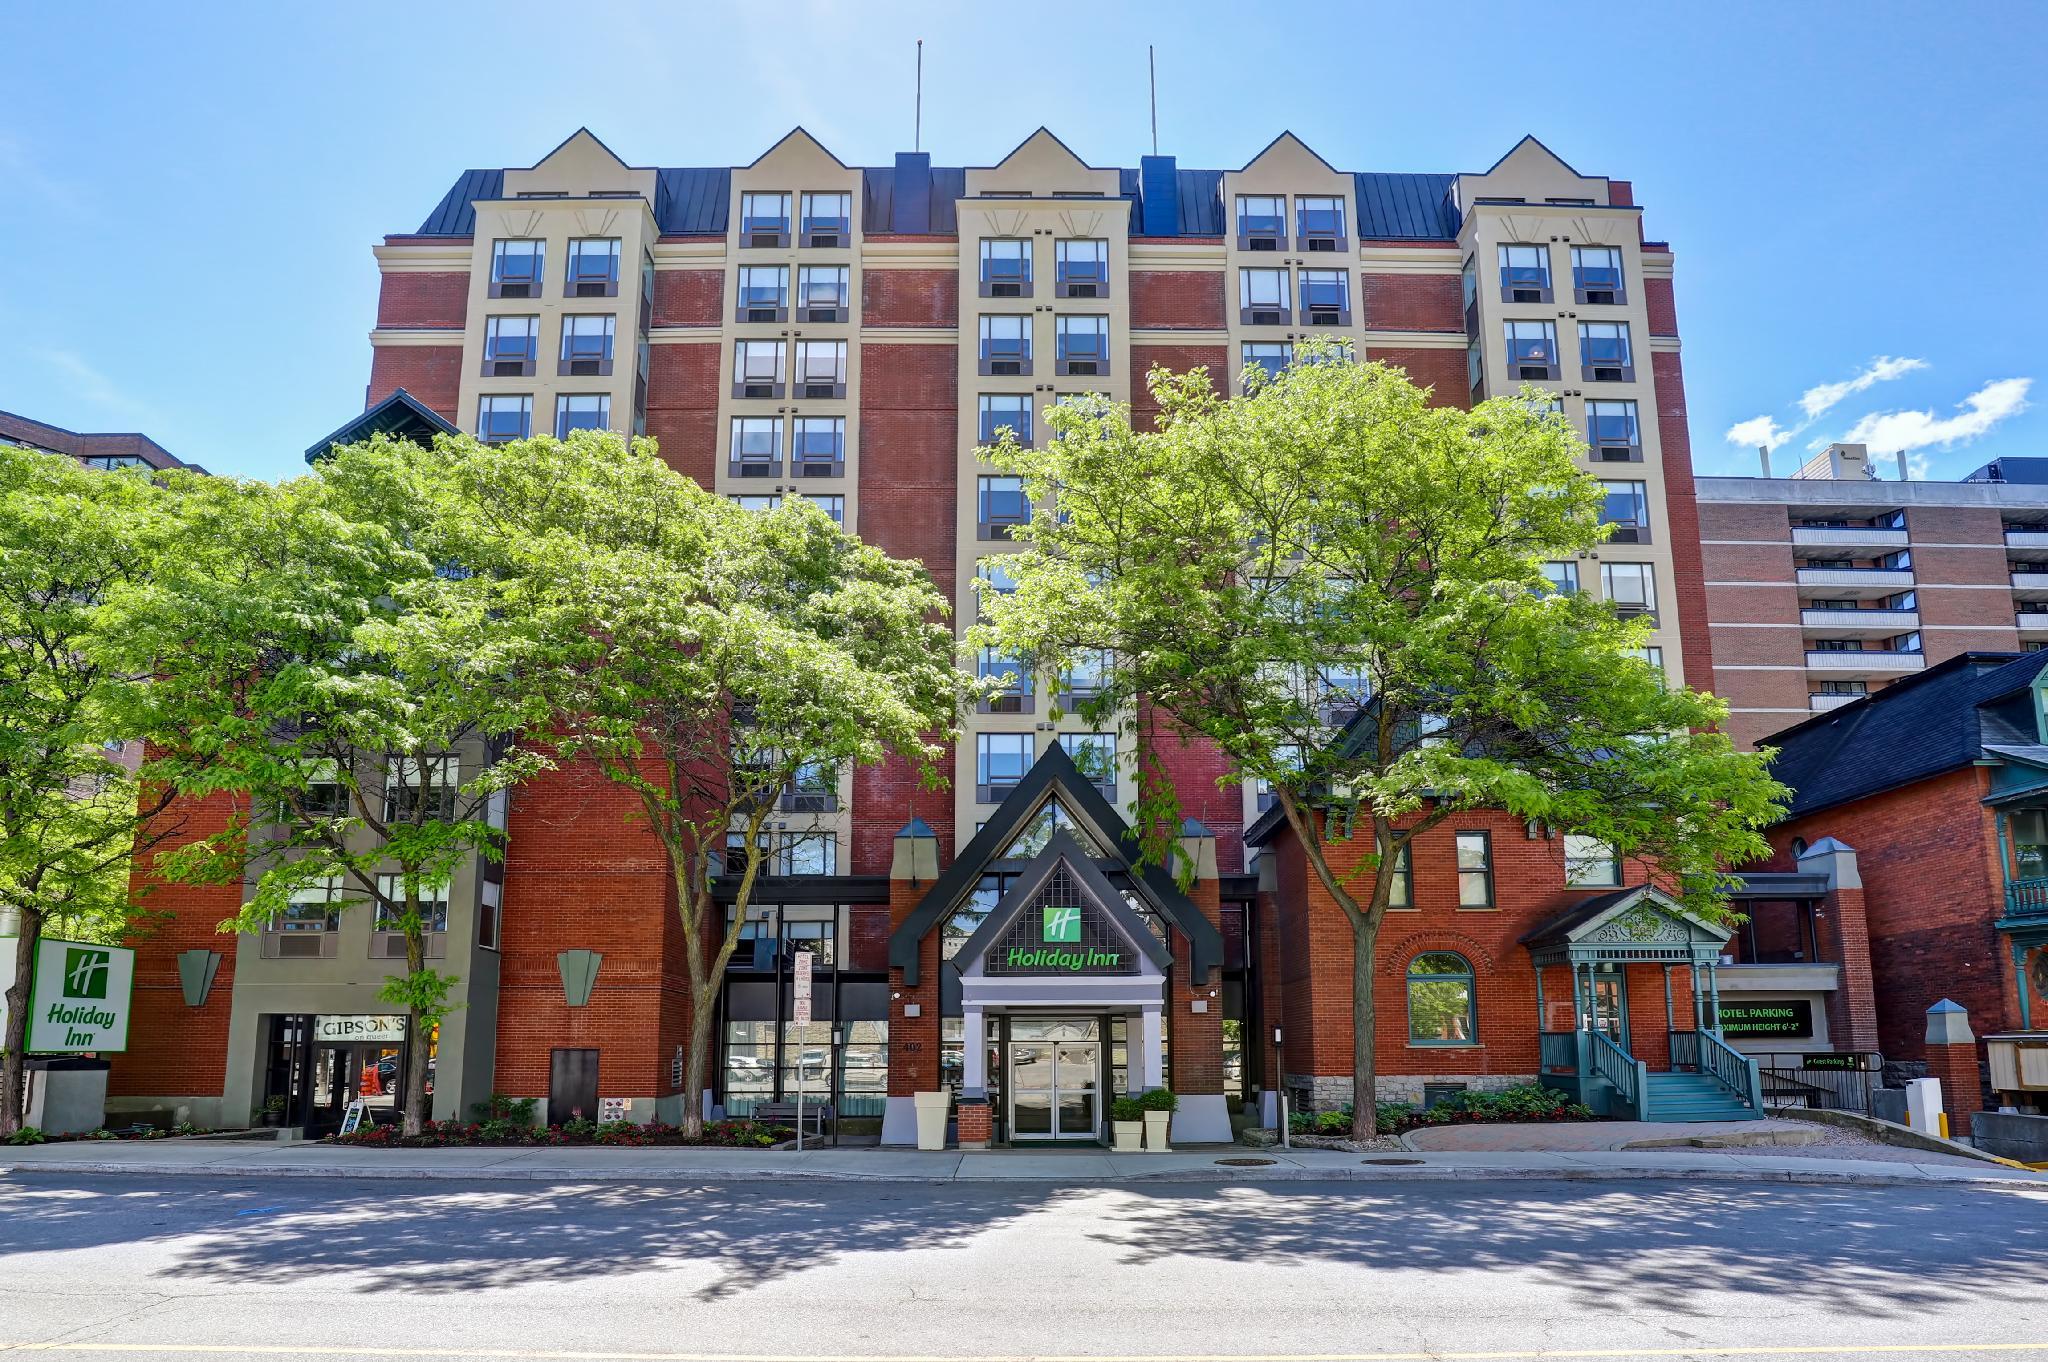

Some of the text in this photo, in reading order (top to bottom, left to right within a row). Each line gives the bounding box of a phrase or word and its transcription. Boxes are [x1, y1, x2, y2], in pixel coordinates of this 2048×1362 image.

[1007, 948, 1119, 971] Holiday Inn
[47, 1003, 116, 1029] Holiday
[1749, 1008, 1794, 1018] PARKING
[323, 1017, 405, 1035] GIBSON'S
[1711, 1023, 1751, 1031] XIMUM
[64, 1026, 94, 1046] Inn
[903, 1042, 922, 1052] 402
